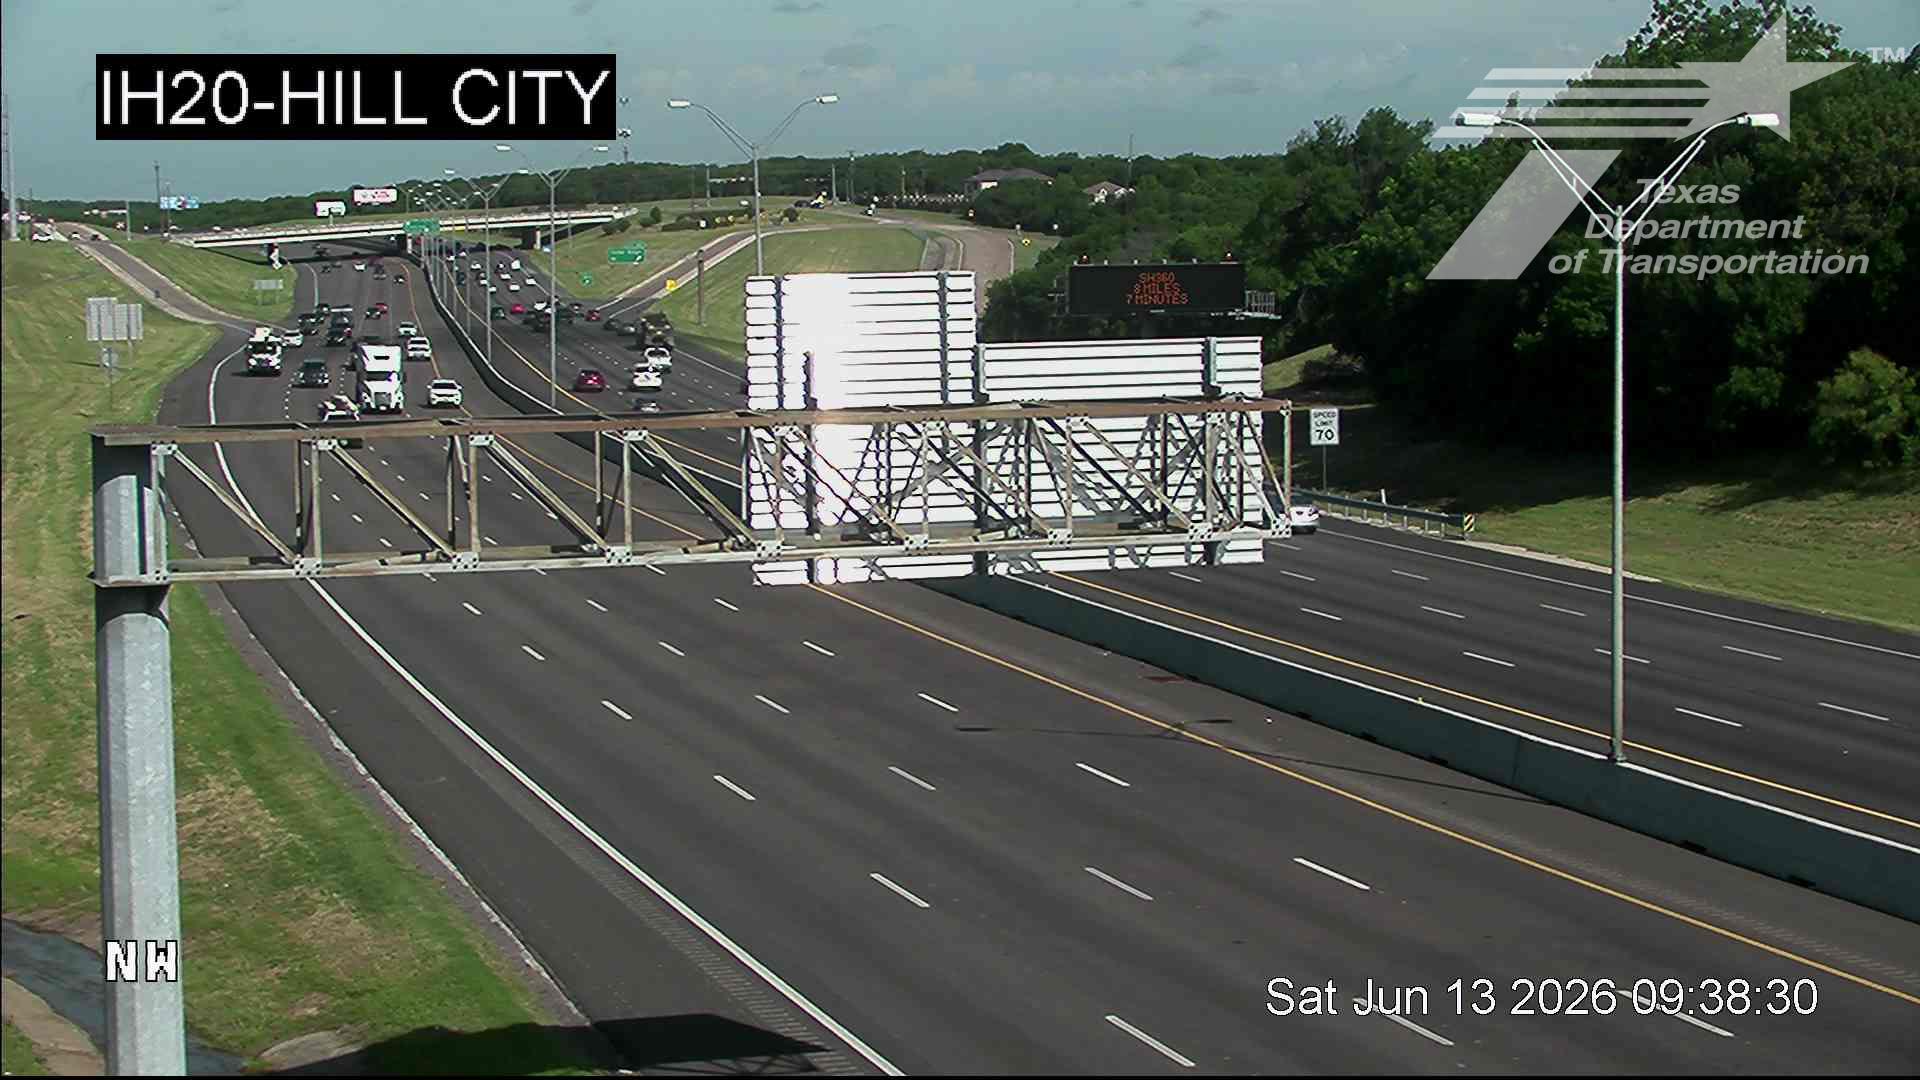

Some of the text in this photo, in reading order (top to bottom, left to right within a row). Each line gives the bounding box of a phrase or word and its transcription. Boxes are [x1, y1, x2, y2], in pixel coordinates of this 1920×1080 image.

[1143, 282, 1181, 294] MILES
[1135, 293, 1189, 305] MINUTES
[1315, 429, 1334, 441] 70
